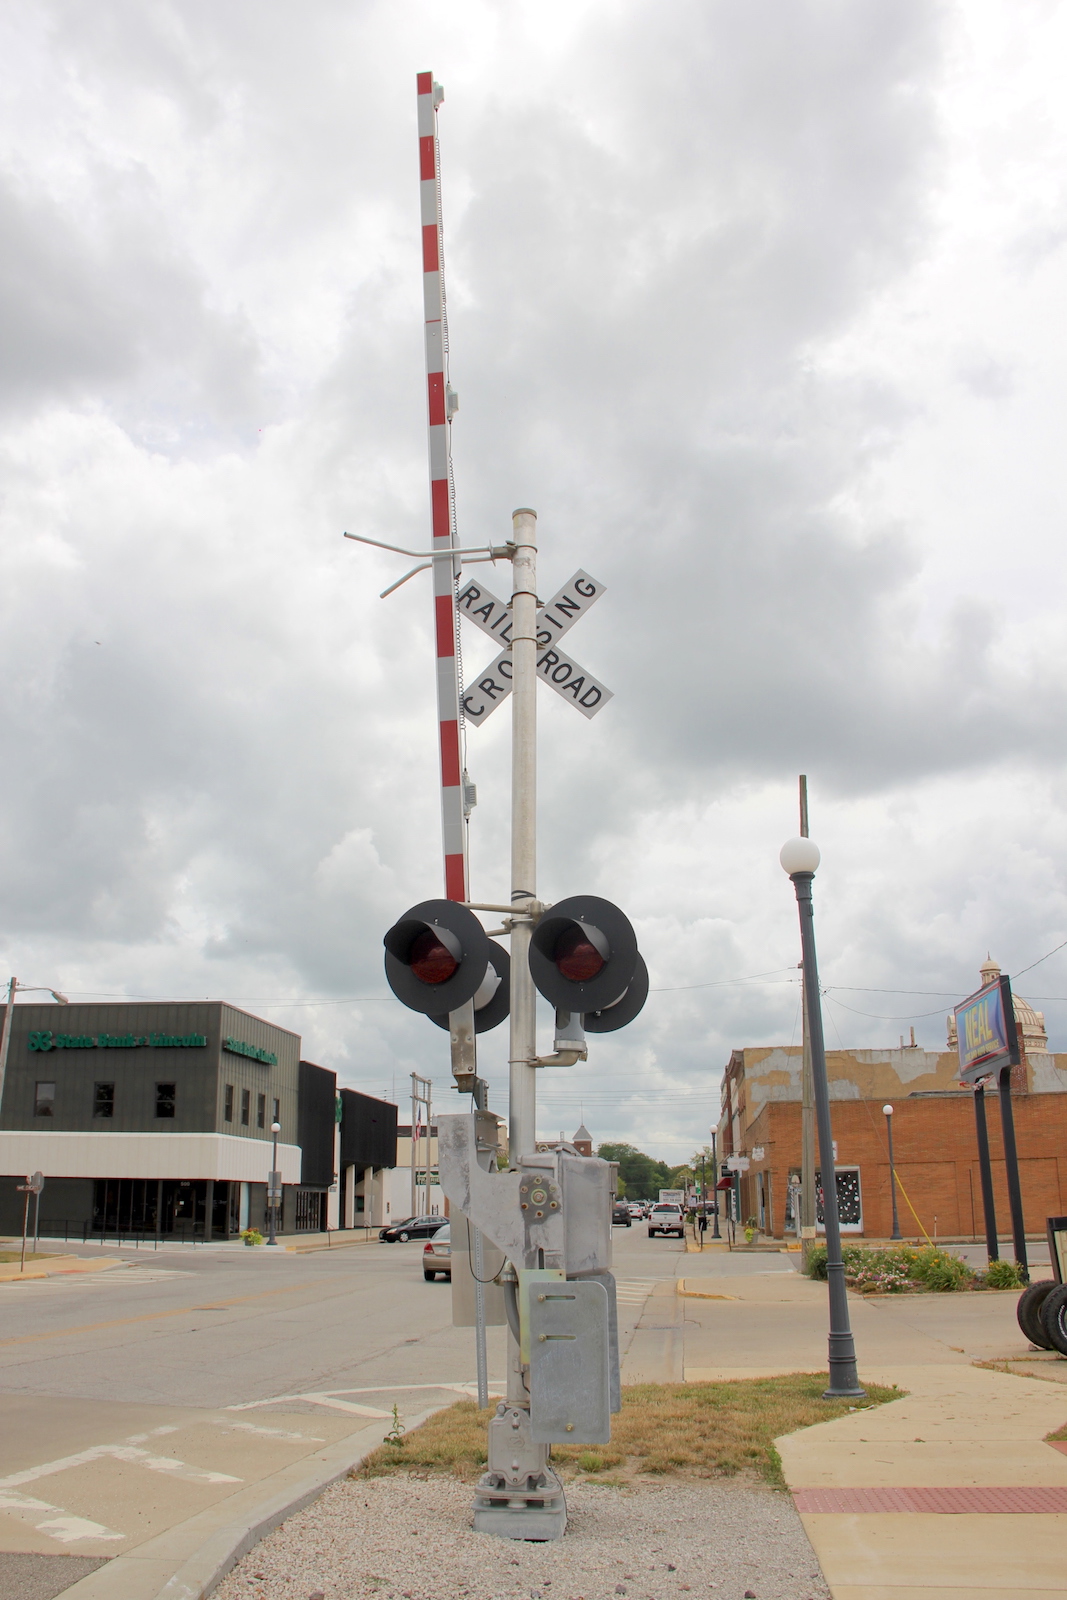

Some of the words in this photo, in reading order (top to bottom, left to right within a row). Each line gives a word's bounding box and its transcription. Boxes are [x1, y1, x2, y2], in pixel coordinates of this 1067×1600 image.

[55, 1033, 95, 1048] State
[97, 1033, 136, 1047] Bank
[149, 1032, 207, 1047] Lincoln
[964, 999, 993, 1050] NEAL
